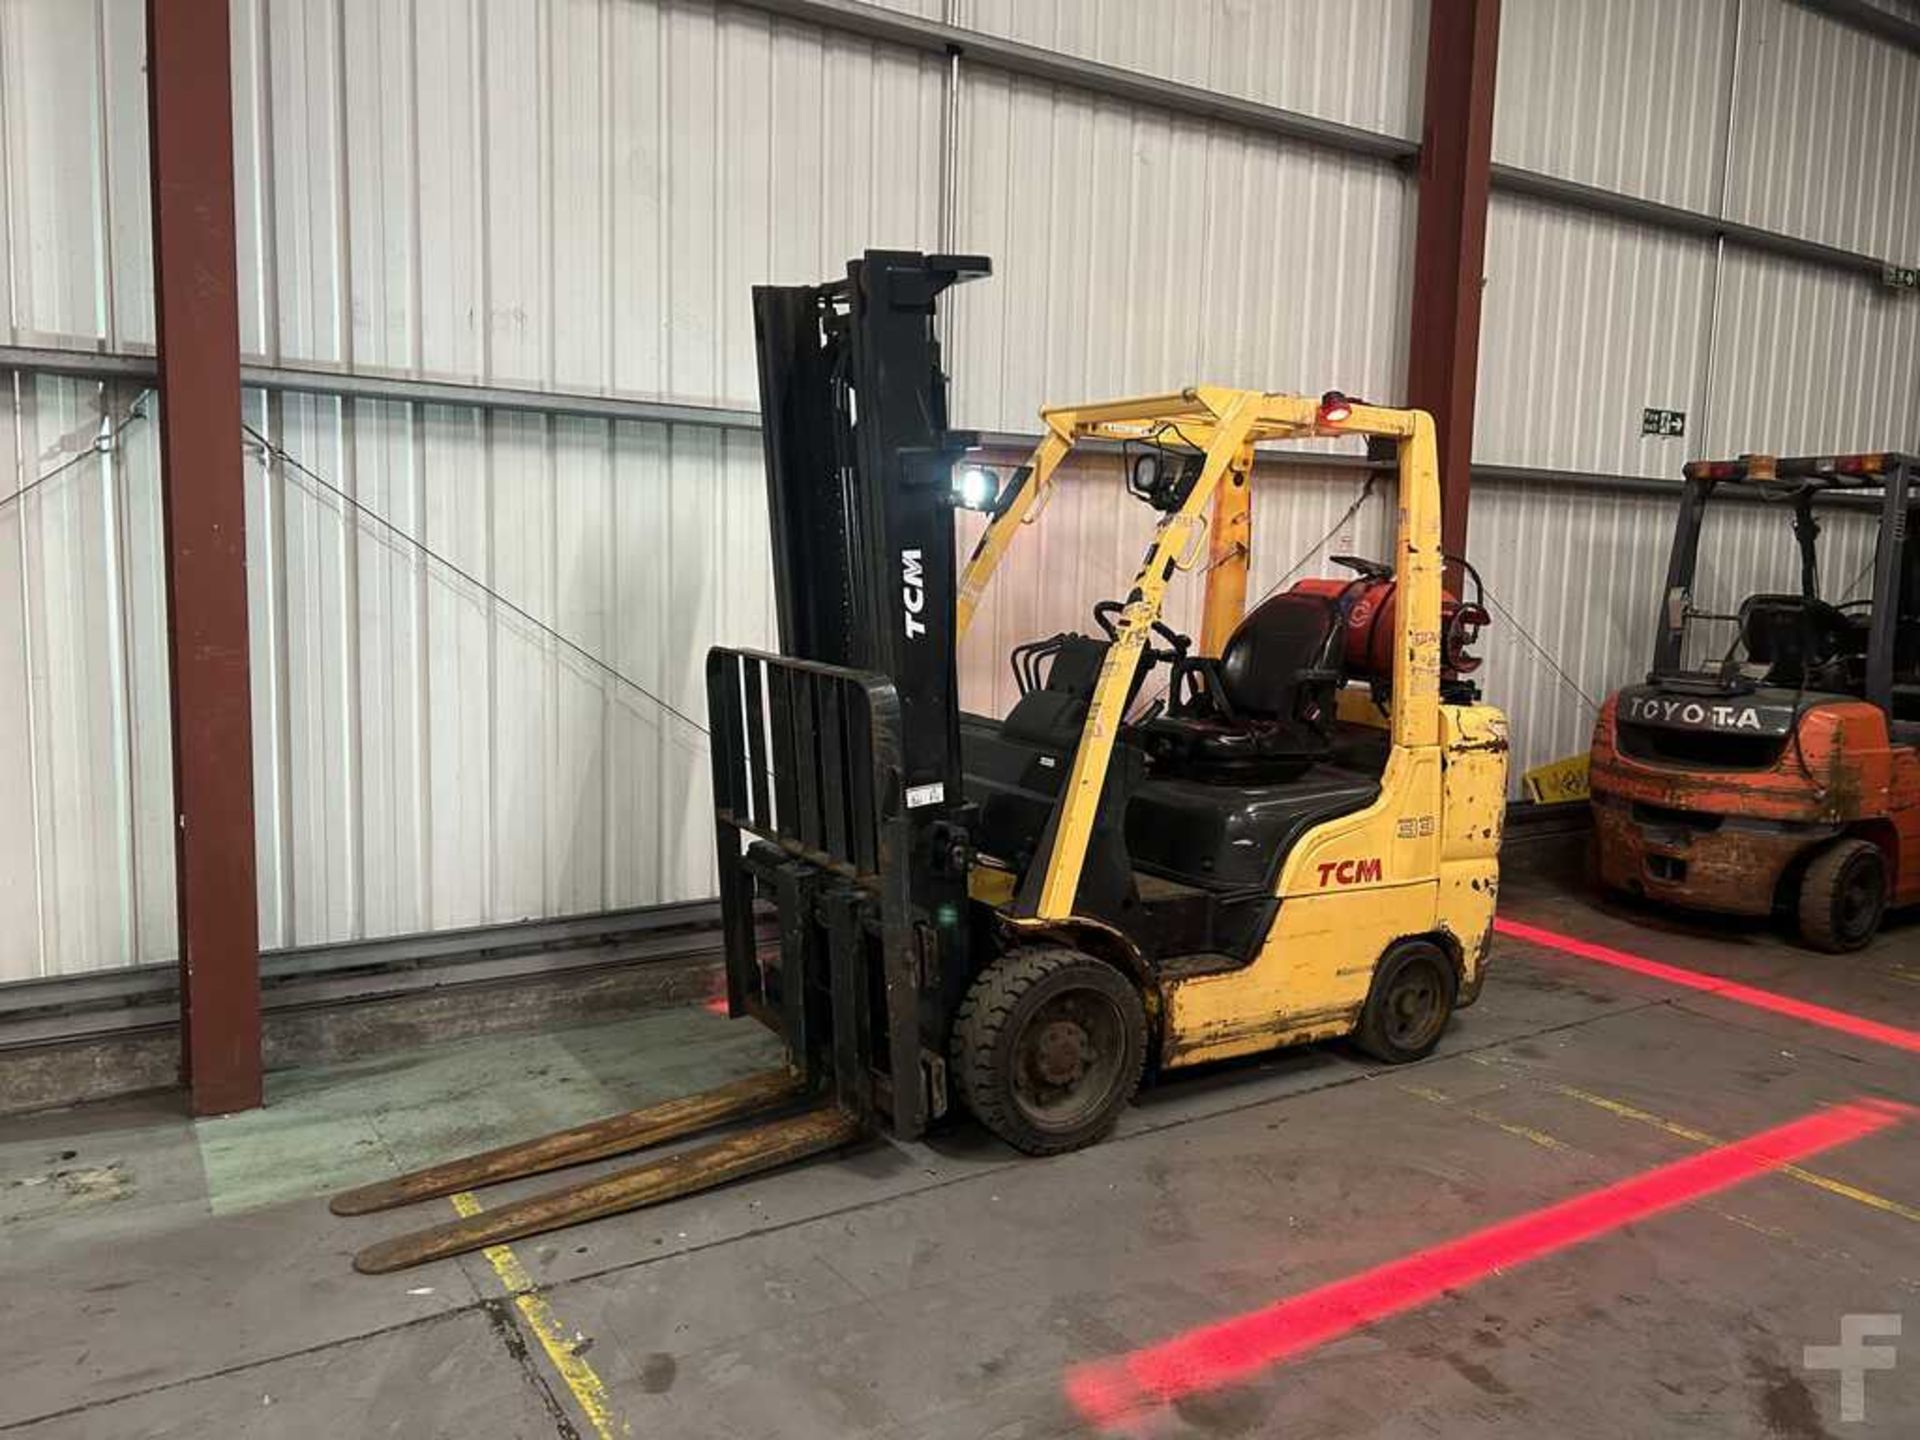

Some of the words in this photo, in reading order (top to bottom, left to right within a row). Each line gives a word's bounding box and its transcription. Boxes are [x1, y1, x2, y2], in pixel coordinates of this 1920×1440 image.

[902, 549, 926, 639] TCM
[1630, 698, 1760, 729] TOYOTA
[1318, 858, 1383, 888] TCM
